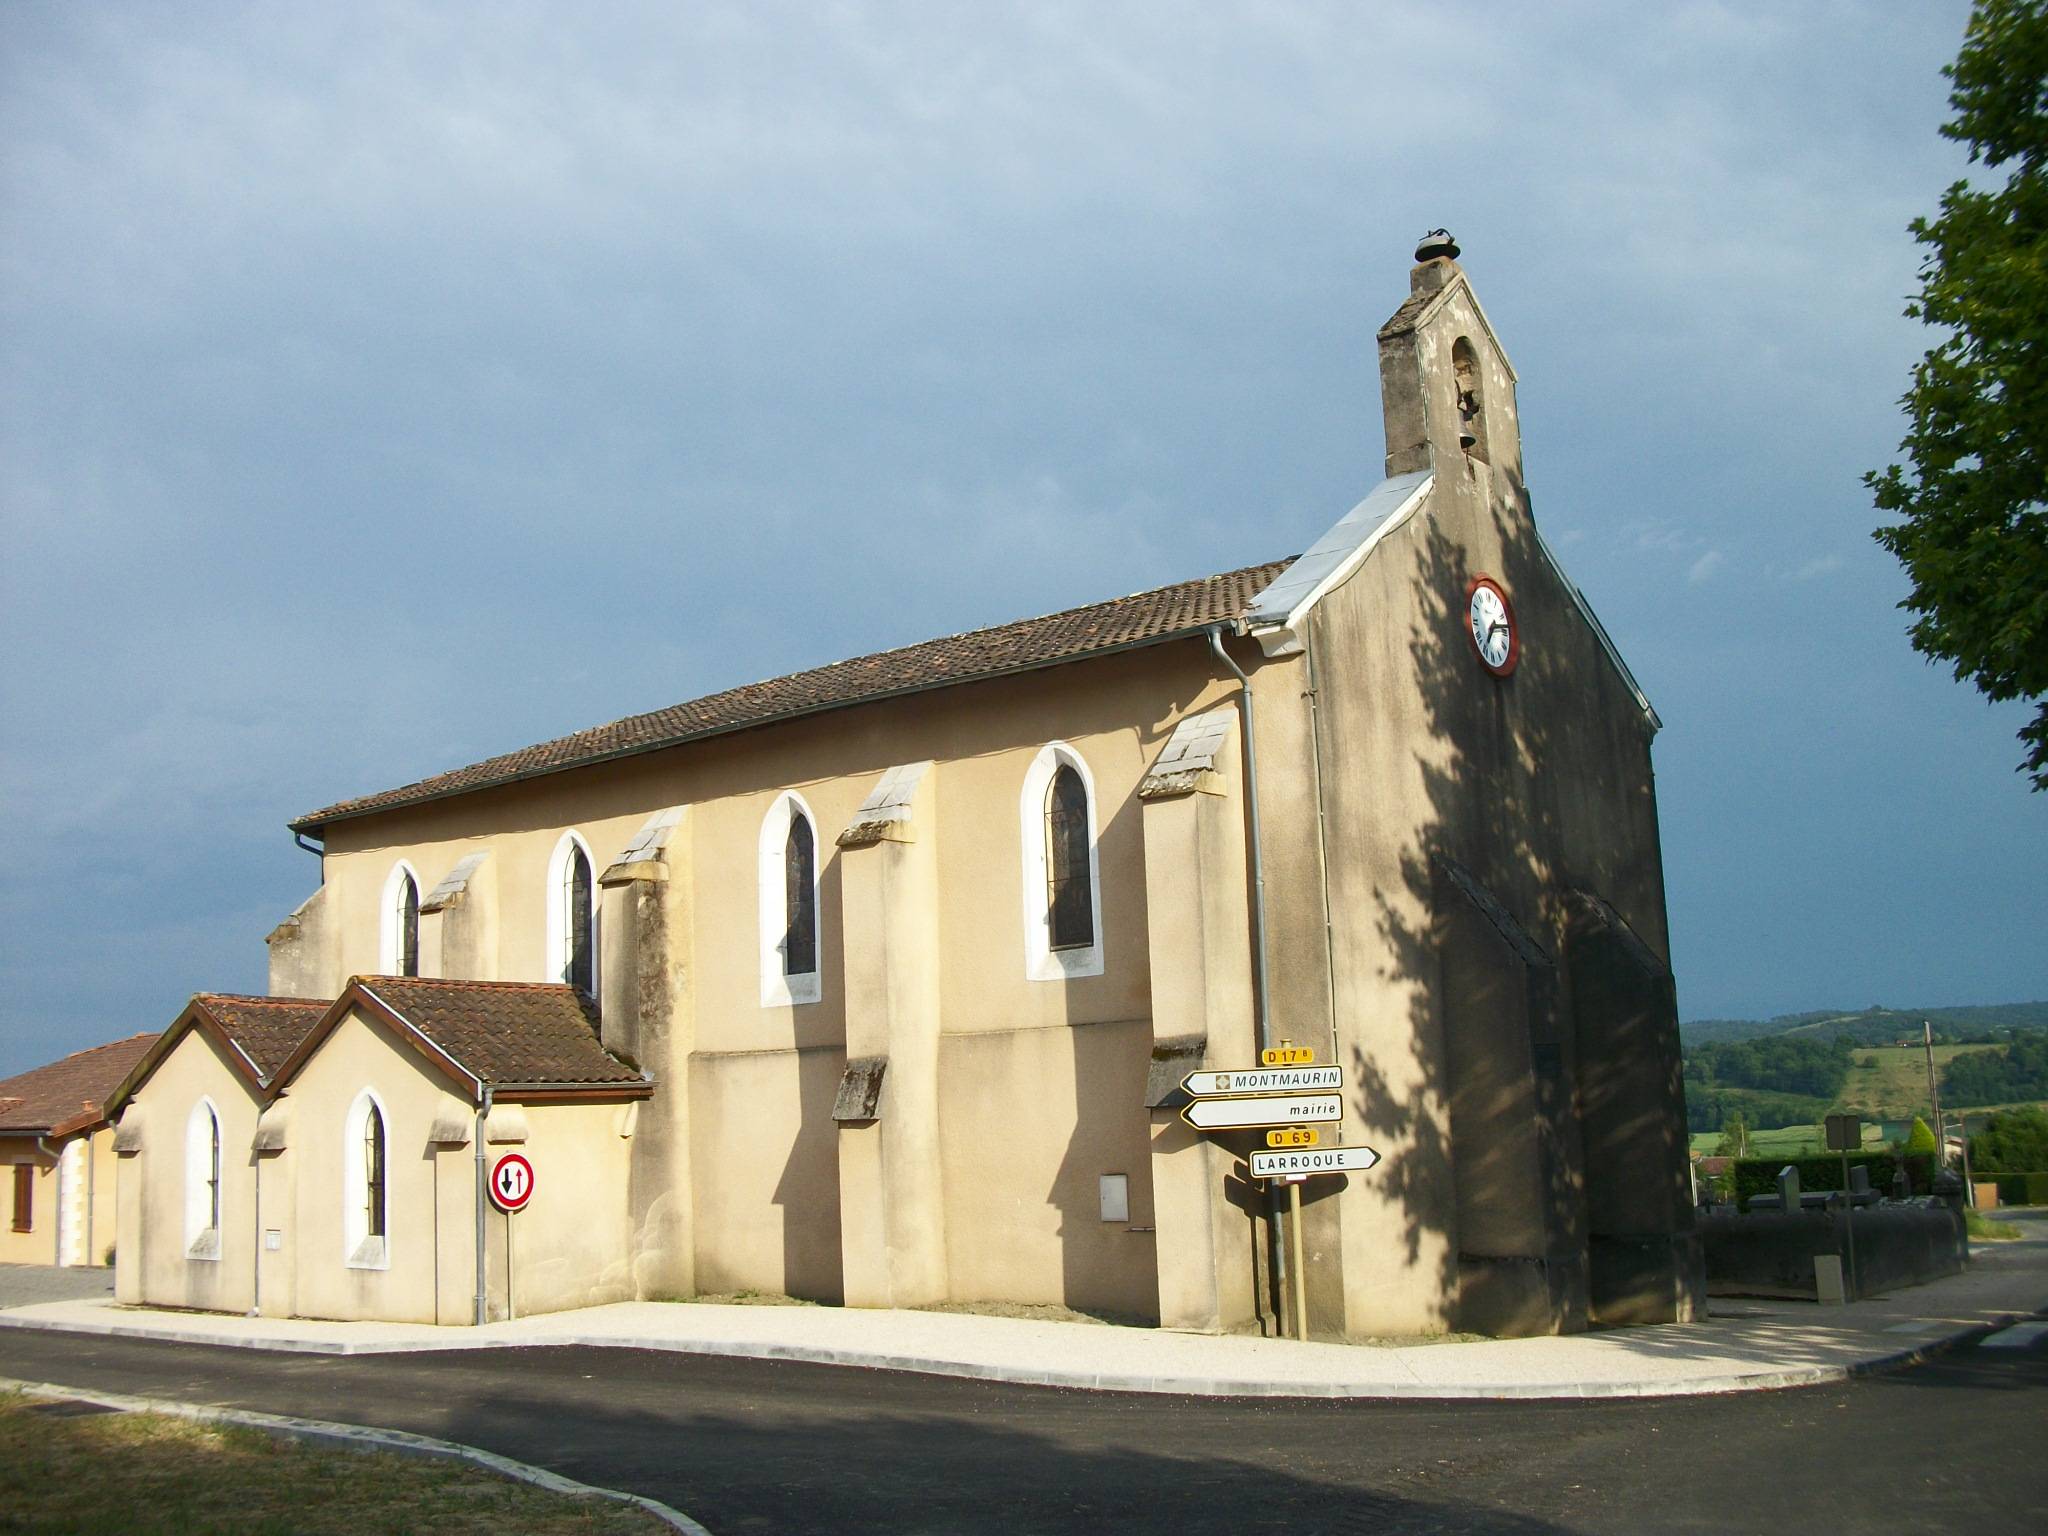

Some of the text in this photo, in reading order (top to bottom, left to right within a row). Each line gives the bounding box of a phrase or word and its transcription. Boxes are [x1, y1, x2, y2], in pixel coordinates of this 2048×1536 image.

[1268, 1052, 1276, 1063] D
[1235, 1071, 1338, 1087] MONTMAURIN
[1290, 1103, 1336, 1116] mairie
[1275, 1131, 1311, 1145] D 69
[1258, 1154, 1345, 1170] LARROQUE
